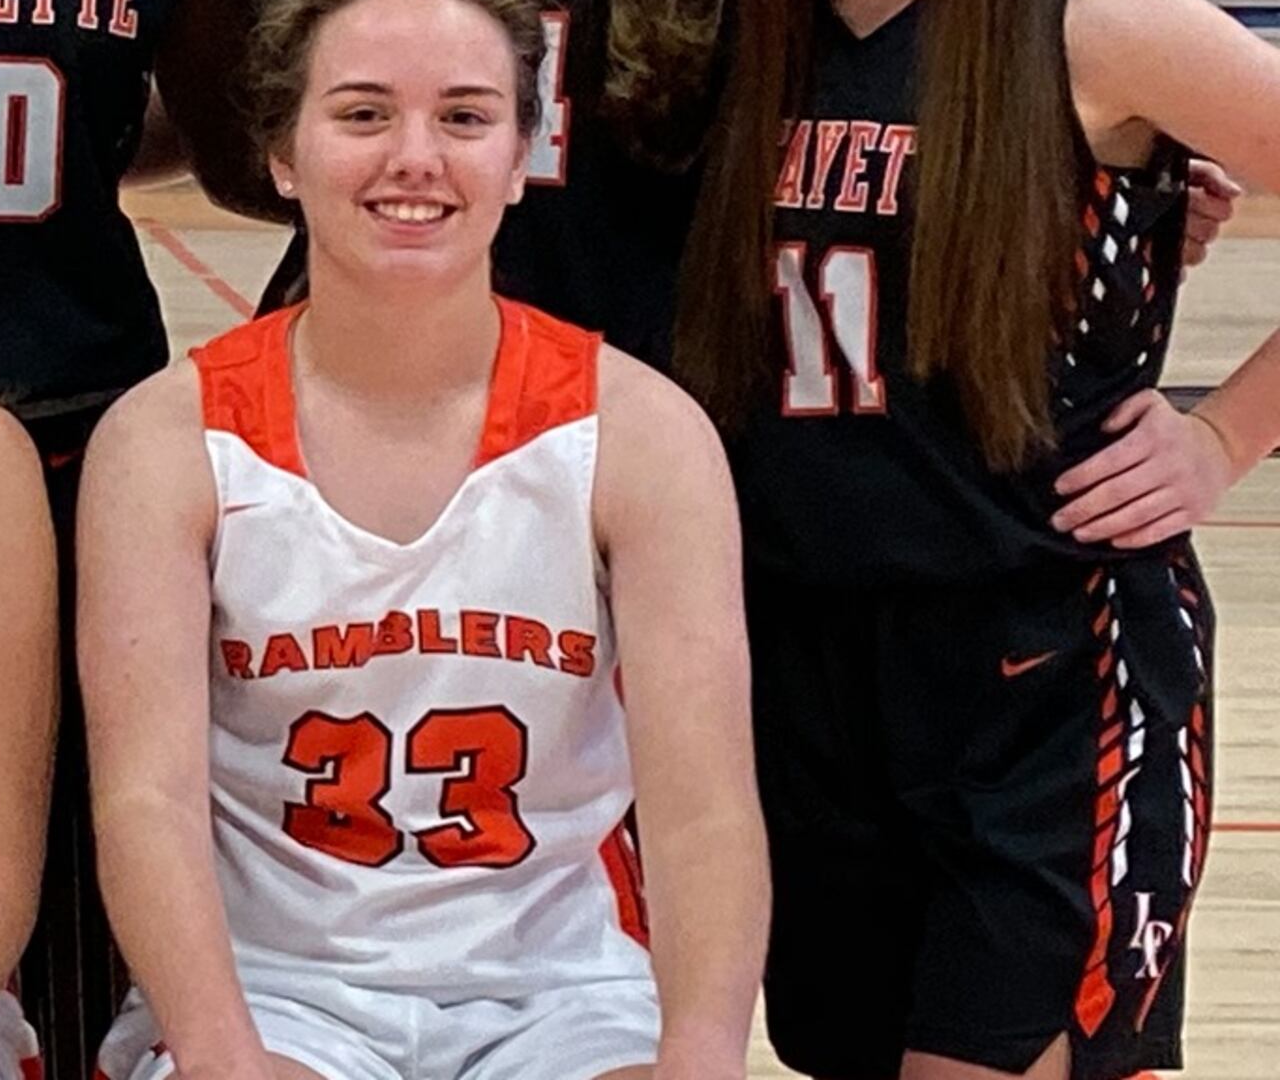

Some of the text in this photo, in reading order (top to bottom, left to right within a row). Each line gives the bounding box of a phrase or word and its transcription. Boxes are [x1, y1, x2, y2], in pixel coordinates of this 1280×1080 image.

[771, 240, 887, 417] 11
[220, 608, 598, 679] RAMBLERS
[282, 704, 537, 869] 33
